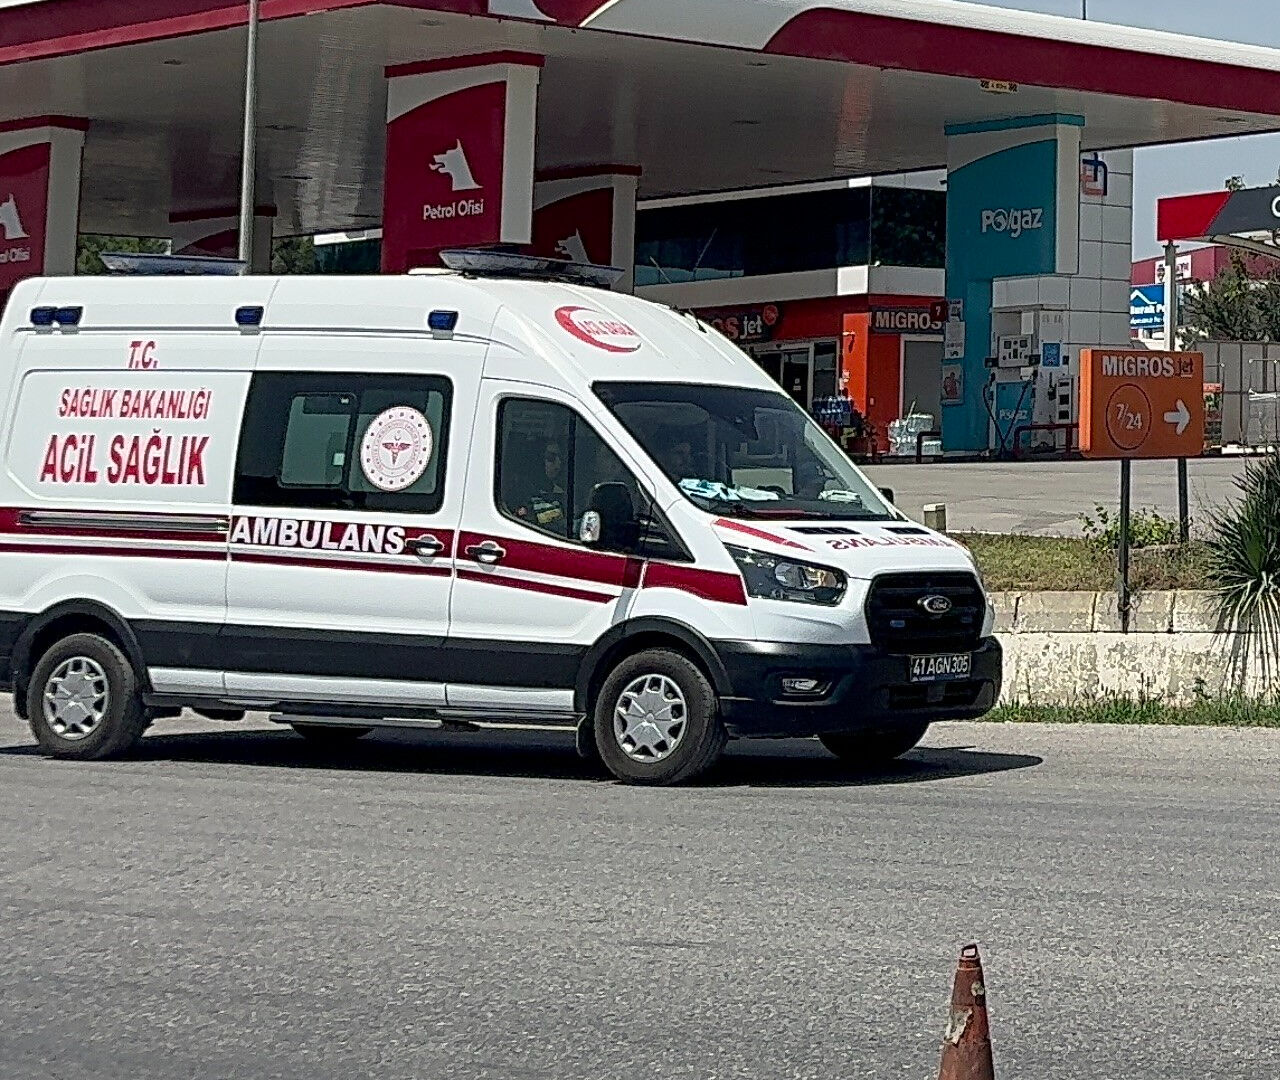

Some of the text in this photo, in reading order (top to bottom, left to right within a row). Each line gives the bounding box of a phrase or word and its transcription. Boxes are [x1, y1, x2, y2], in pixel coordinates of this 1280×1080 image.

[423, 198, 485, 220] Petrol Ofisi
[740, 315, 762, 340] jet
[128, 340, 158, 369] T.C.
[58, 386, 212, 420] SAĞLIK BAKANLIĞI
[1116, 403, 1143, 430] 7/24
[107, 428, 209, 485] SAĞLIK
[231, 516, 406, 554] AMBULANS
[913, 655, 969, 676] 41 AGN 305
